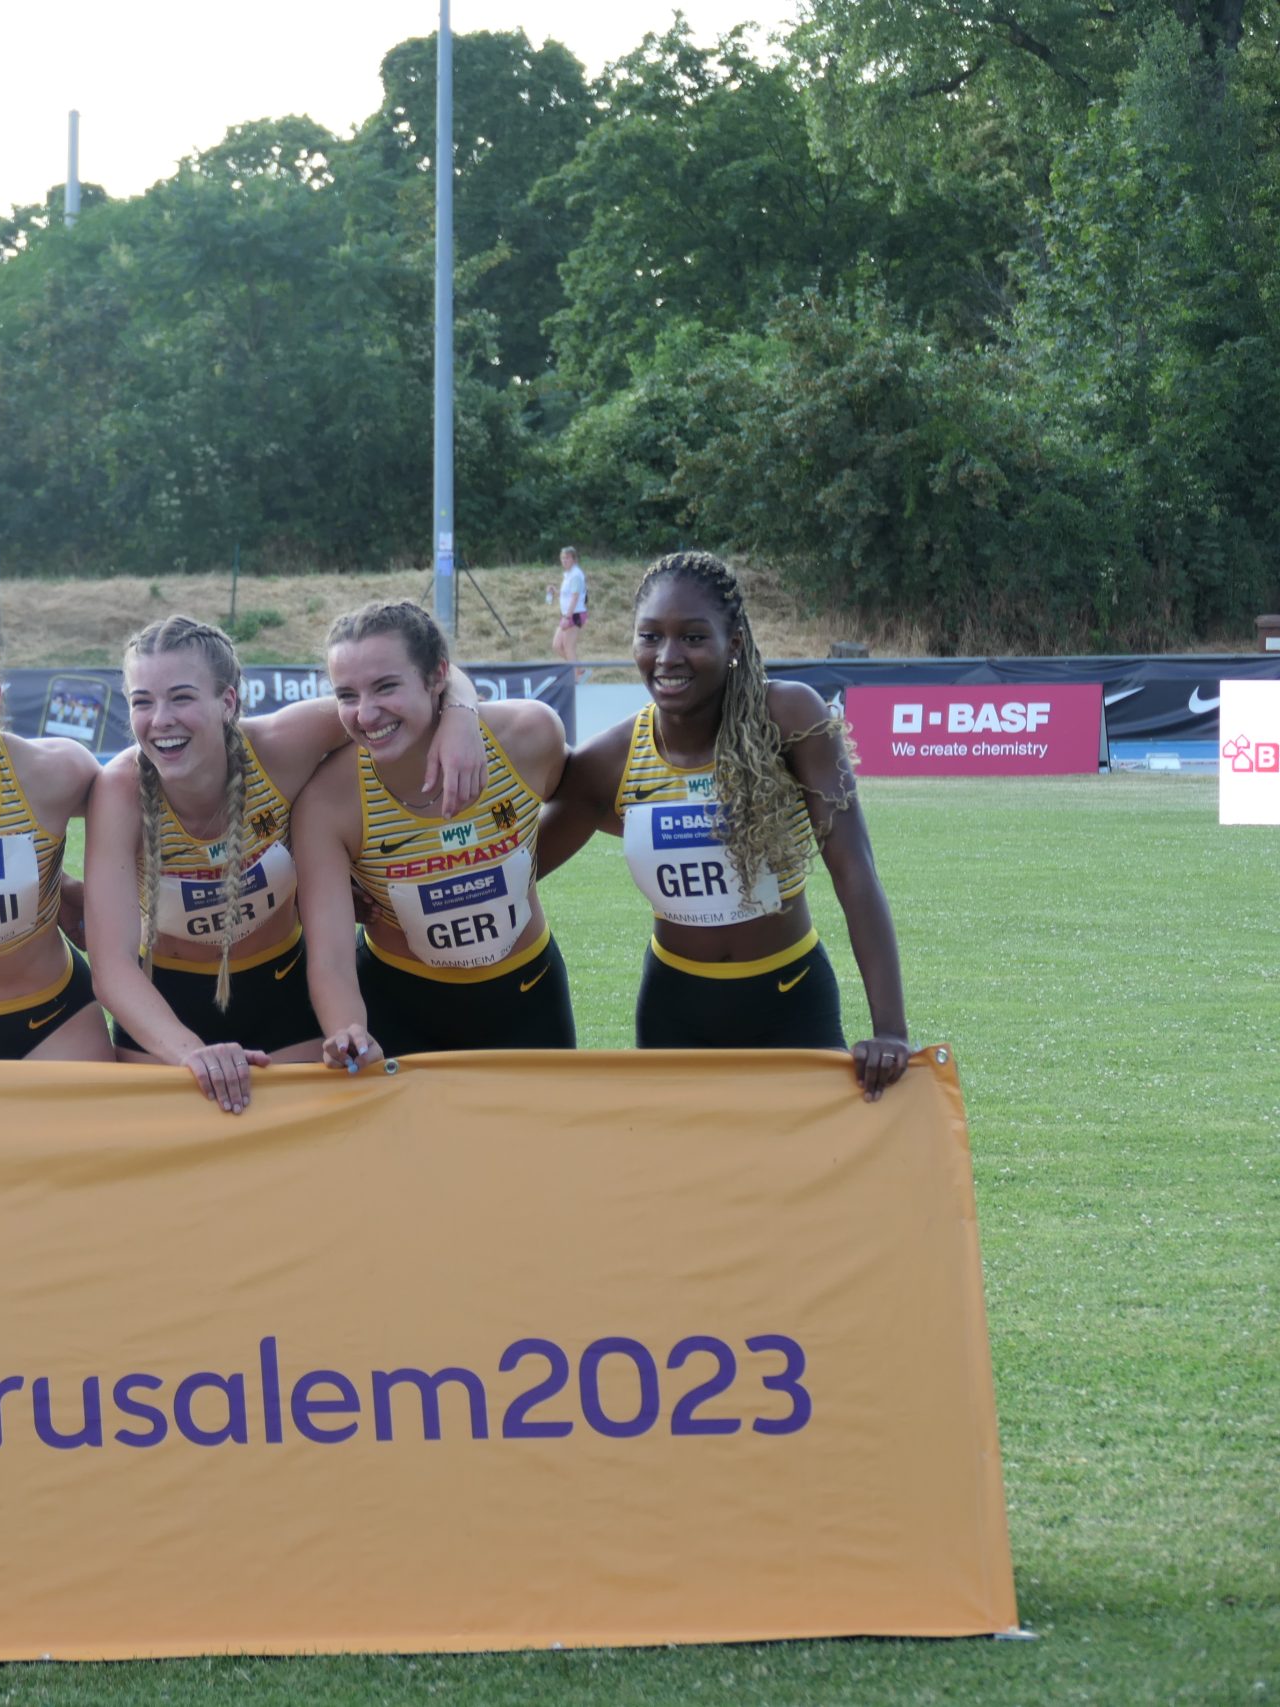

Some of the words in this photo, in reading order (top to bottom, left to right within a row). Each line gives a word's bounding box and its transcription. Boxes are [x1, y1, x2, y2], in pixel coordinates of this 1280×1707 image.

[948, 703, 1050, 733] BASF
[892, 743, 917, 756] We
[920, 743, 968, 756] create
[972, 742, 1048, 759] chemistry
[673, 832, 693, 840] create
[386, 830, 521, 879] GERMANY
[452, 876, 495, 896] BASF
[656, 861, 728, 898] GER
[465, 888, 497, 901] chemistry
[186, 902, 256, 936] GER
[267, 892, 275, 910] I
[664, 911, 724, 923] MANNHEIM
[427, 912, 499, 950] GER
[507, 904, 517, 930] I
[430, 954, 496, 968] MANNHEIM
